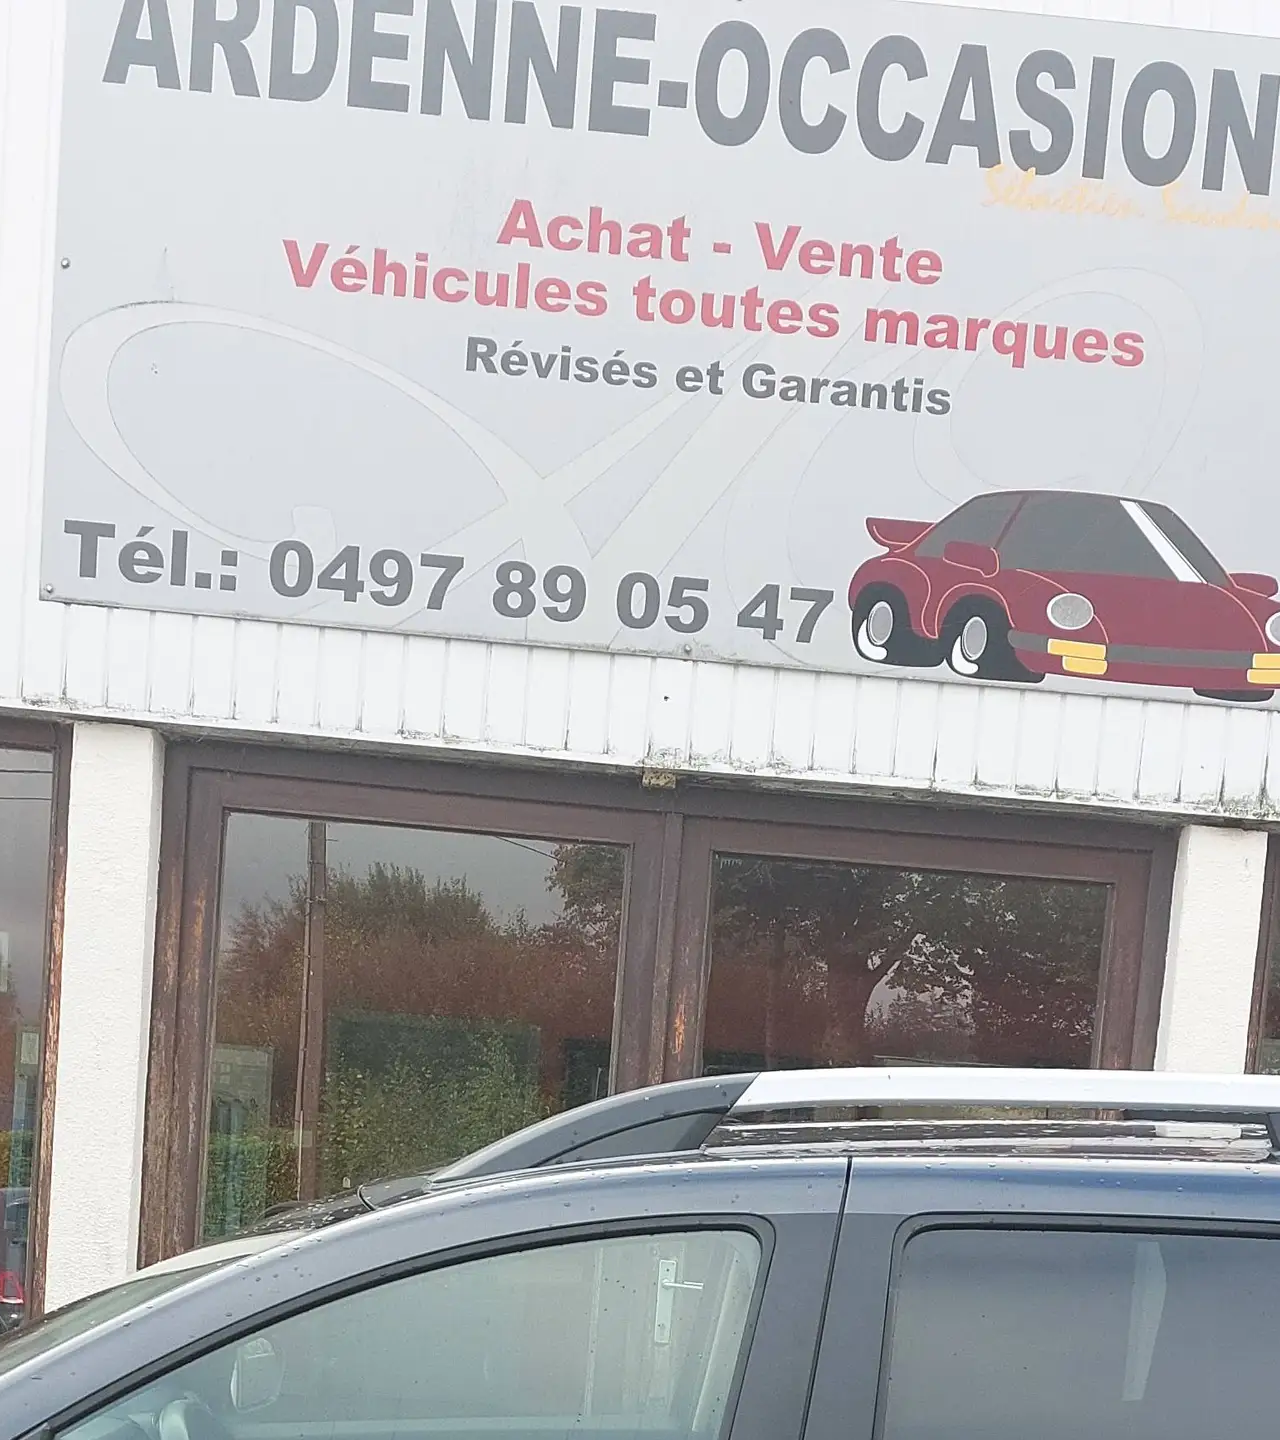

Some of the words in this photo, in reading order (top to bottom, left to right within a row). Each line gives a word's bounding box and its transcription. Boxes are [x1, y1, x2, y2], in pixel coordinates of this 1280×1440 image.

[497, 199, 691, 262] Achat
[754, 221, 944, 286] Vente
[282, 239, 609, 317] Véhicules
[632, 276, 840, 339] toutes
[864, 307, 1145, 369] marques
[465, 336, 658, 389] Révisés
[675, 360, 725, 396] et
[742, 363, 951, 416] Garantis
[63, 519, 239, 592] Tél.:
[268, 540, 465, 611] 0497
[491, 560, 587, 623] 89
[615, 571, 710, 634] 05
[735, 583, 835, 644] 47
